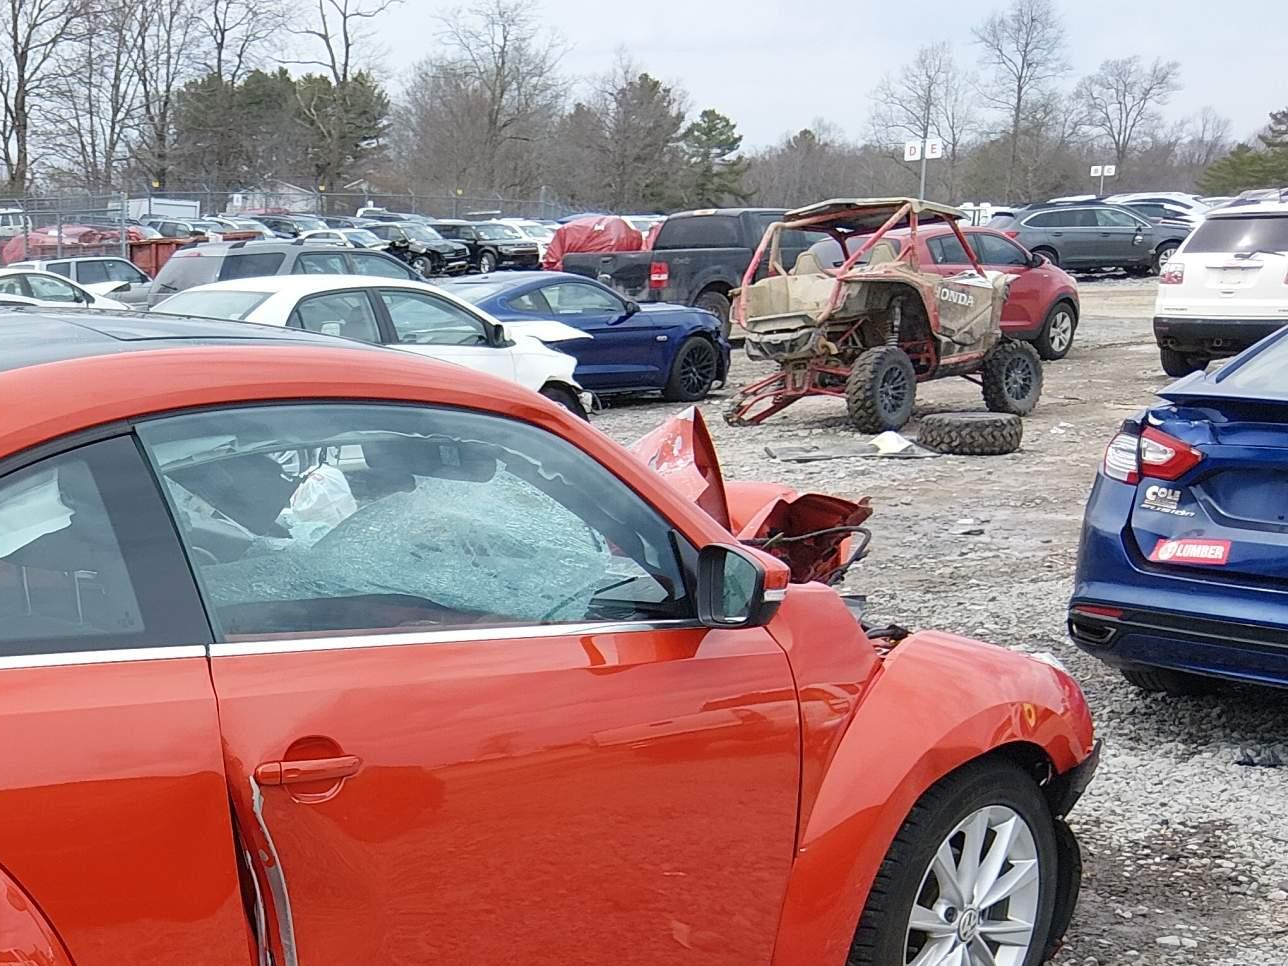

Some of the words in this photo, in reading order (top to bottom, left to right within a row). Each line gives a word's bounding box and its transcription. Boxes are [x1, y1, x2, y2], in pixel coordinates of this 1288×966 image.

[909, 145, 917, 157] D
[930, 143, 938, 154] E
[1145, 485, 1181, 501] COLE
[1176, 543, 1225, 559] LUMBER
